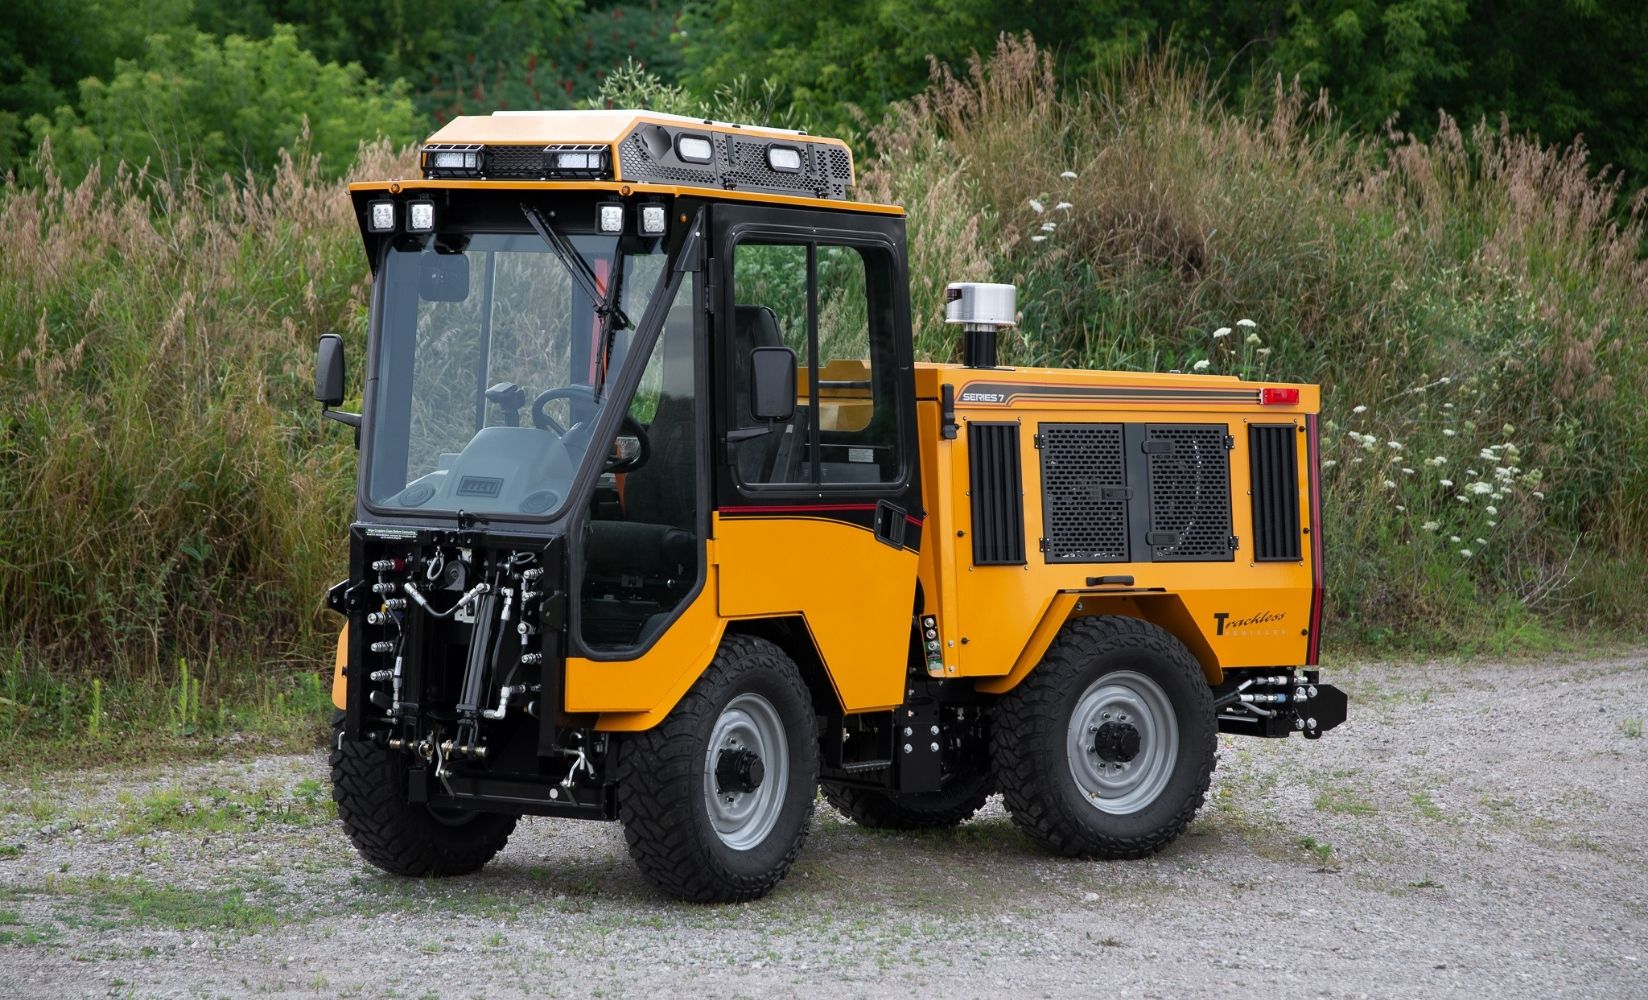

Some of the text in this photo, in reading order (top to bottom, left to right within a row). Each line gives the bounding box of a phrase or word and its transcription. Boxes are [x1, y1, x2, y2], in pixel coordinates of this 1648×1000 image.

[963, 393, 1005, 402] SERIES 7
[1213, 610, 1287, 636] Trackless
